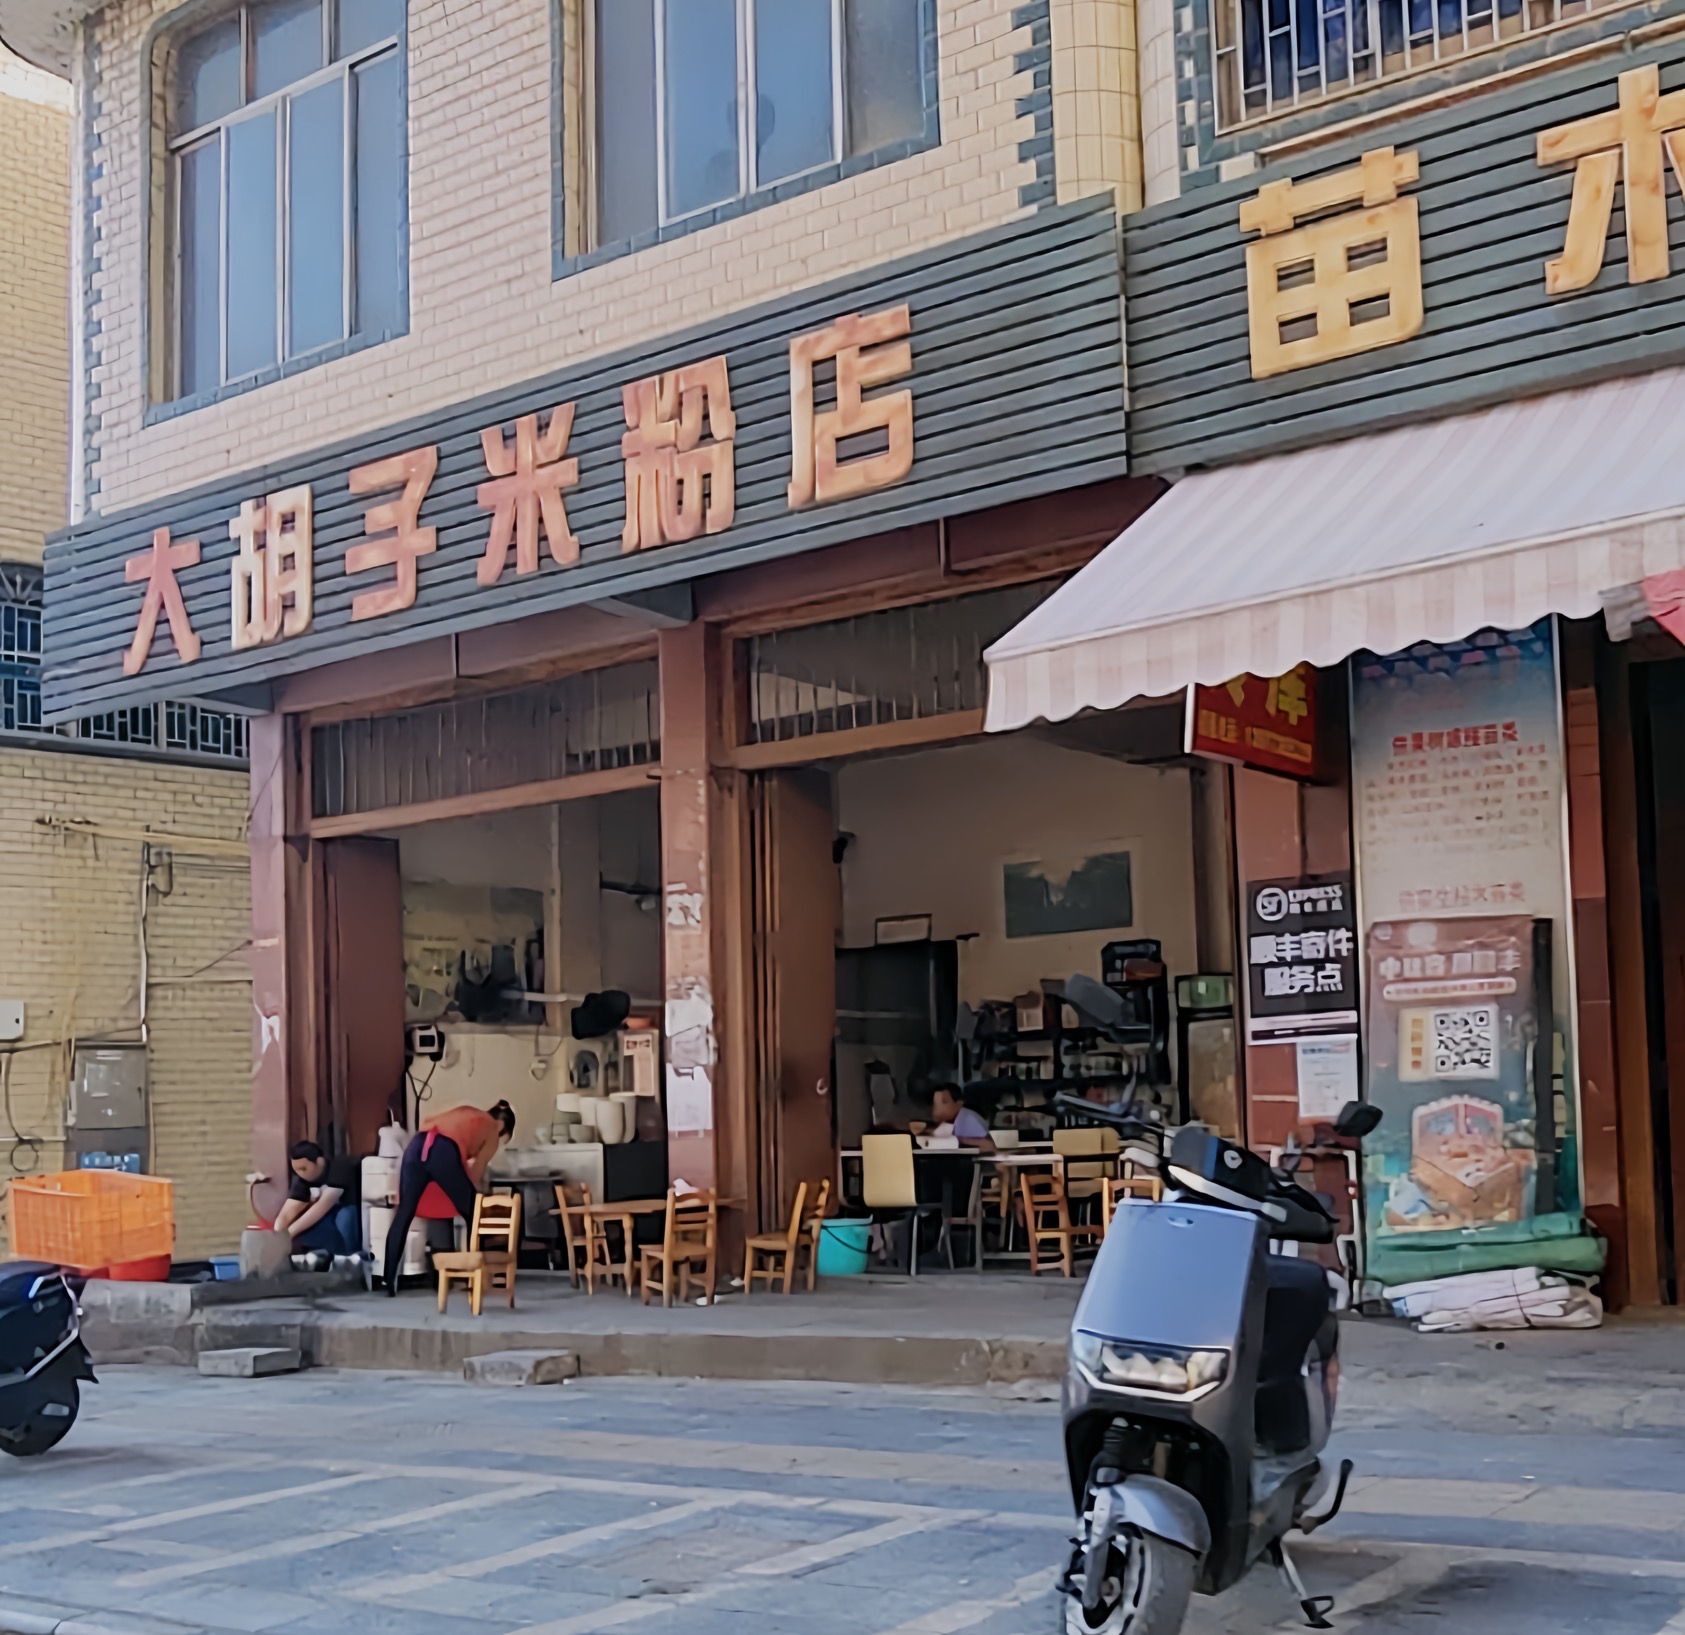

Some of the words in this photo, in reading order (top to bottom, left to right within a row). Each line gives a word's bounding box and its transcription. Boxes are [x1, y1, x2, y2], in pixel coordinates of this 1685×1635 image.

[123, 302, 914, 676] 大胡子米粉店
